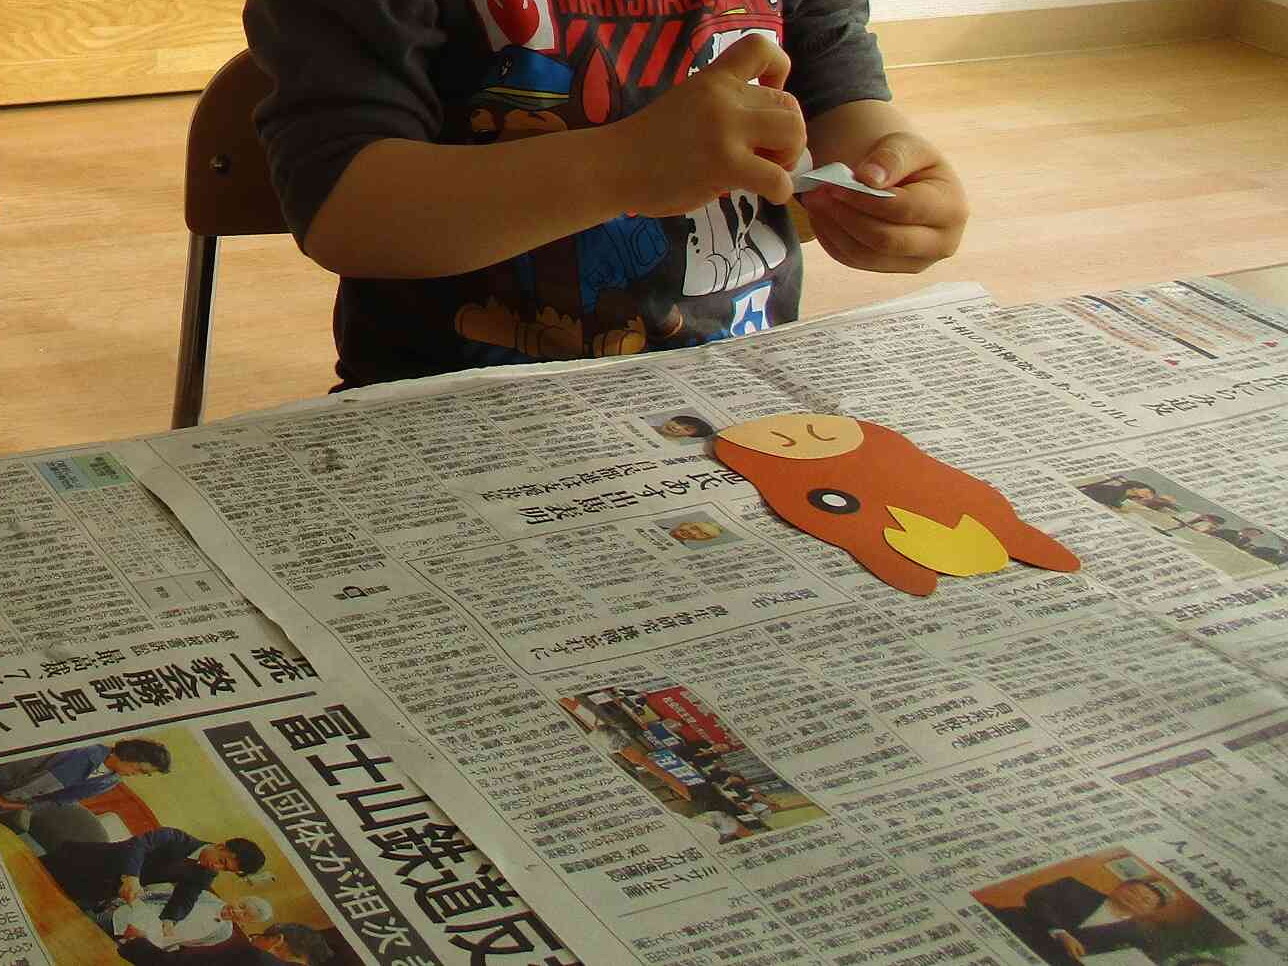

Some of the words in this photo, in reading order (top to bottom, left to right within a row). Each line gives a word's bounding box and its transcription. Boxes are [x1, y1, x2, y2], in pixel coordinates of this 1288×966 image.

[222, 736, 437, 966] 市民団体が相次
[270, 704, 582, 966] 富士山鉄道反
